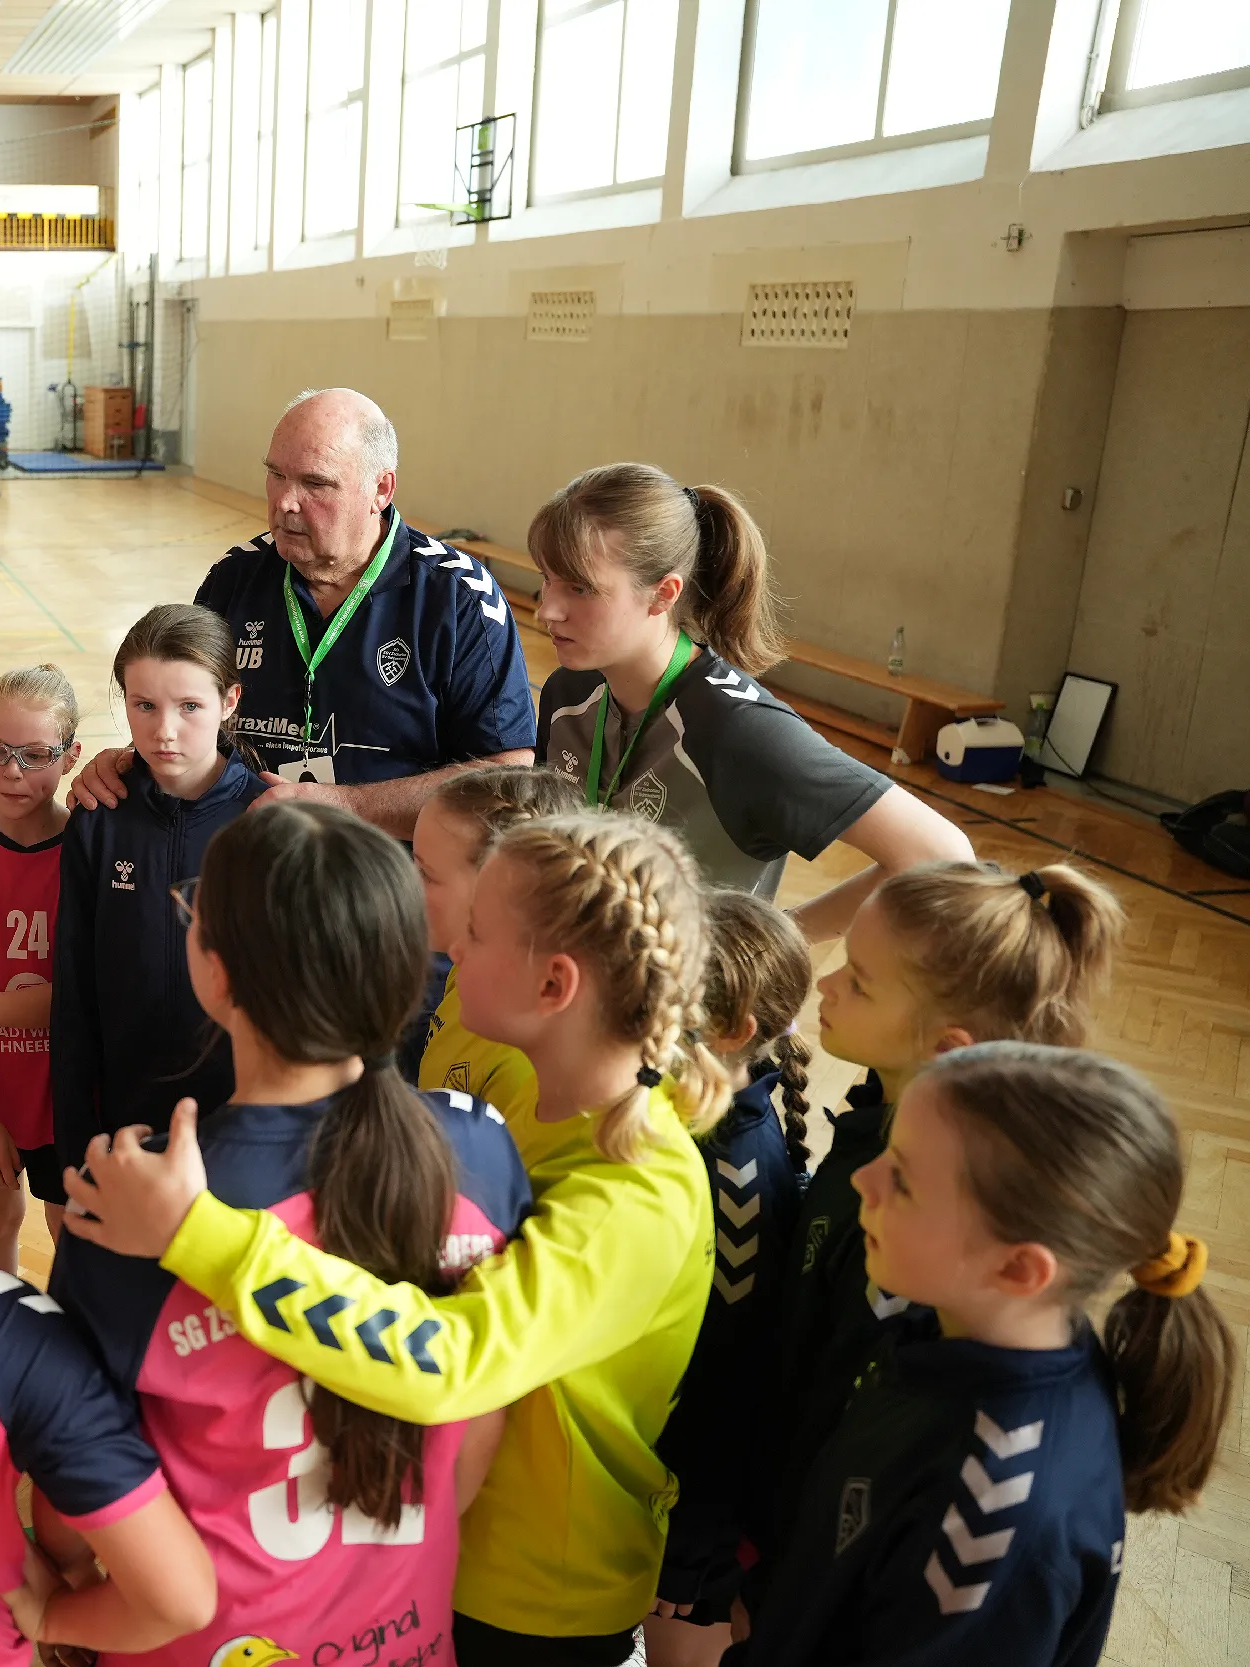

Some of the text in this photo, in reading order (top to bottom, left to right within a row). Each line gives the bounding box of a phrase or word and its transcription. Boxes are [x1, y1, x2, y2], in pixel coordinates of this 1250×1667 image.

[239, 637, 263, 646] hummel
[236, 647, 263, 670] UB
[554, 765, 580, 784] hummel
[111, 879, 135, 891] hummel
[6, 909, 50, 960] 24
[167, 1313, 208, 1357] SG
